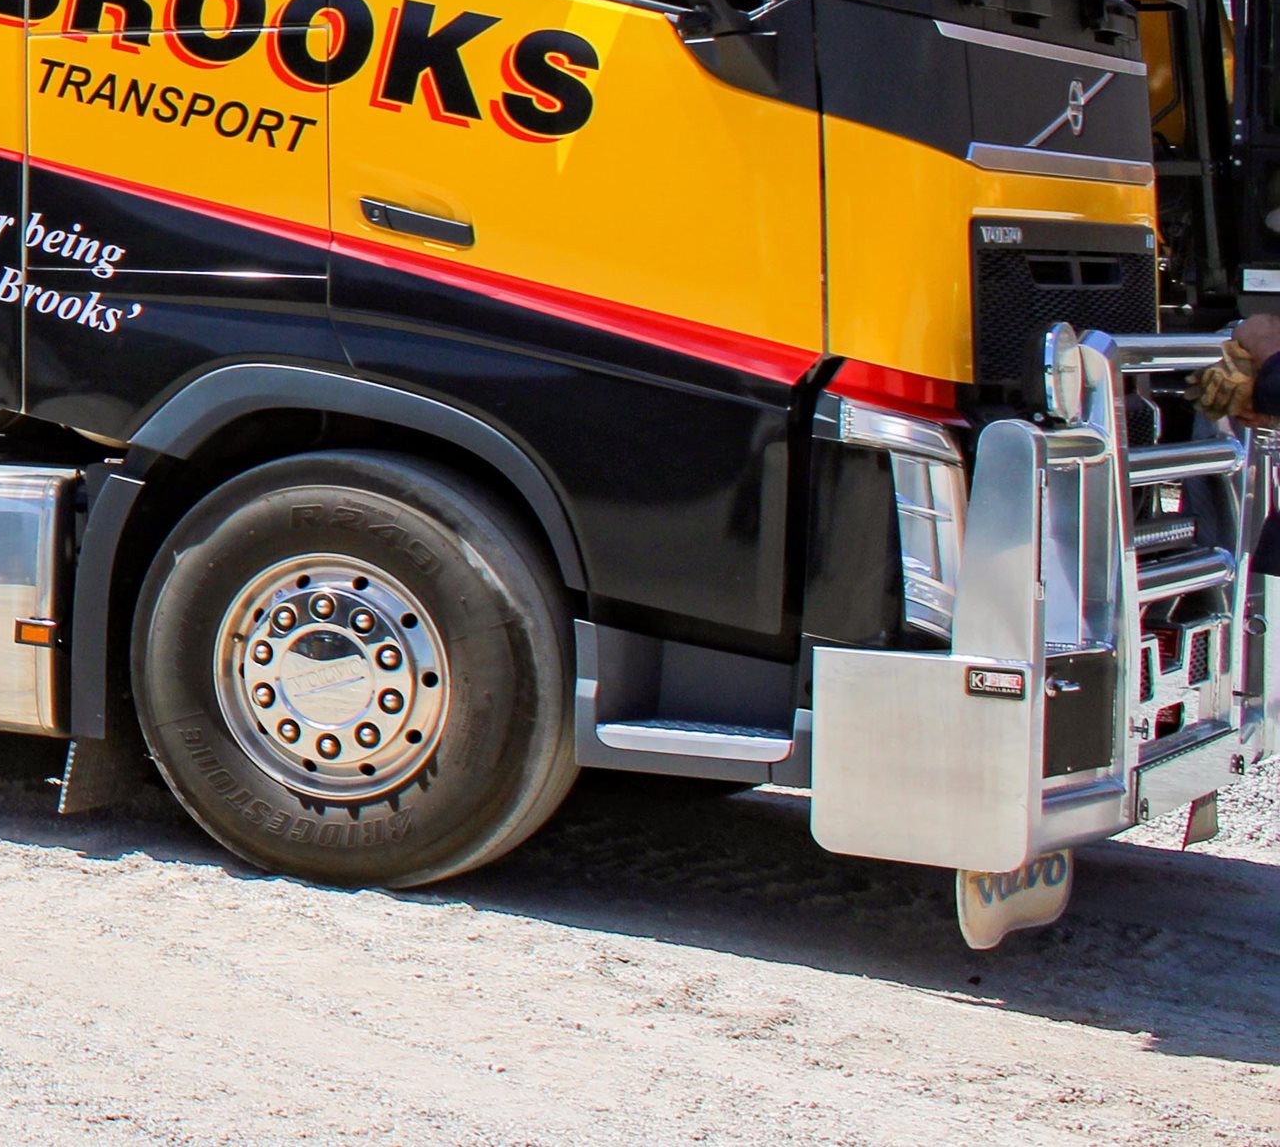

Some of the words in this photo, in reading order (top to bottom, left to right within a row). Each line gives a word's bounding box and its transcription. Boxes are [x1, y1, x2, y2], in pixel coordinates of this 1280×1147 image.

[37, 58, 318, 152] TRANSPORT
[24, 211, 126, 278] being
[176, 726, 417, 849] BRIDGESTONE
